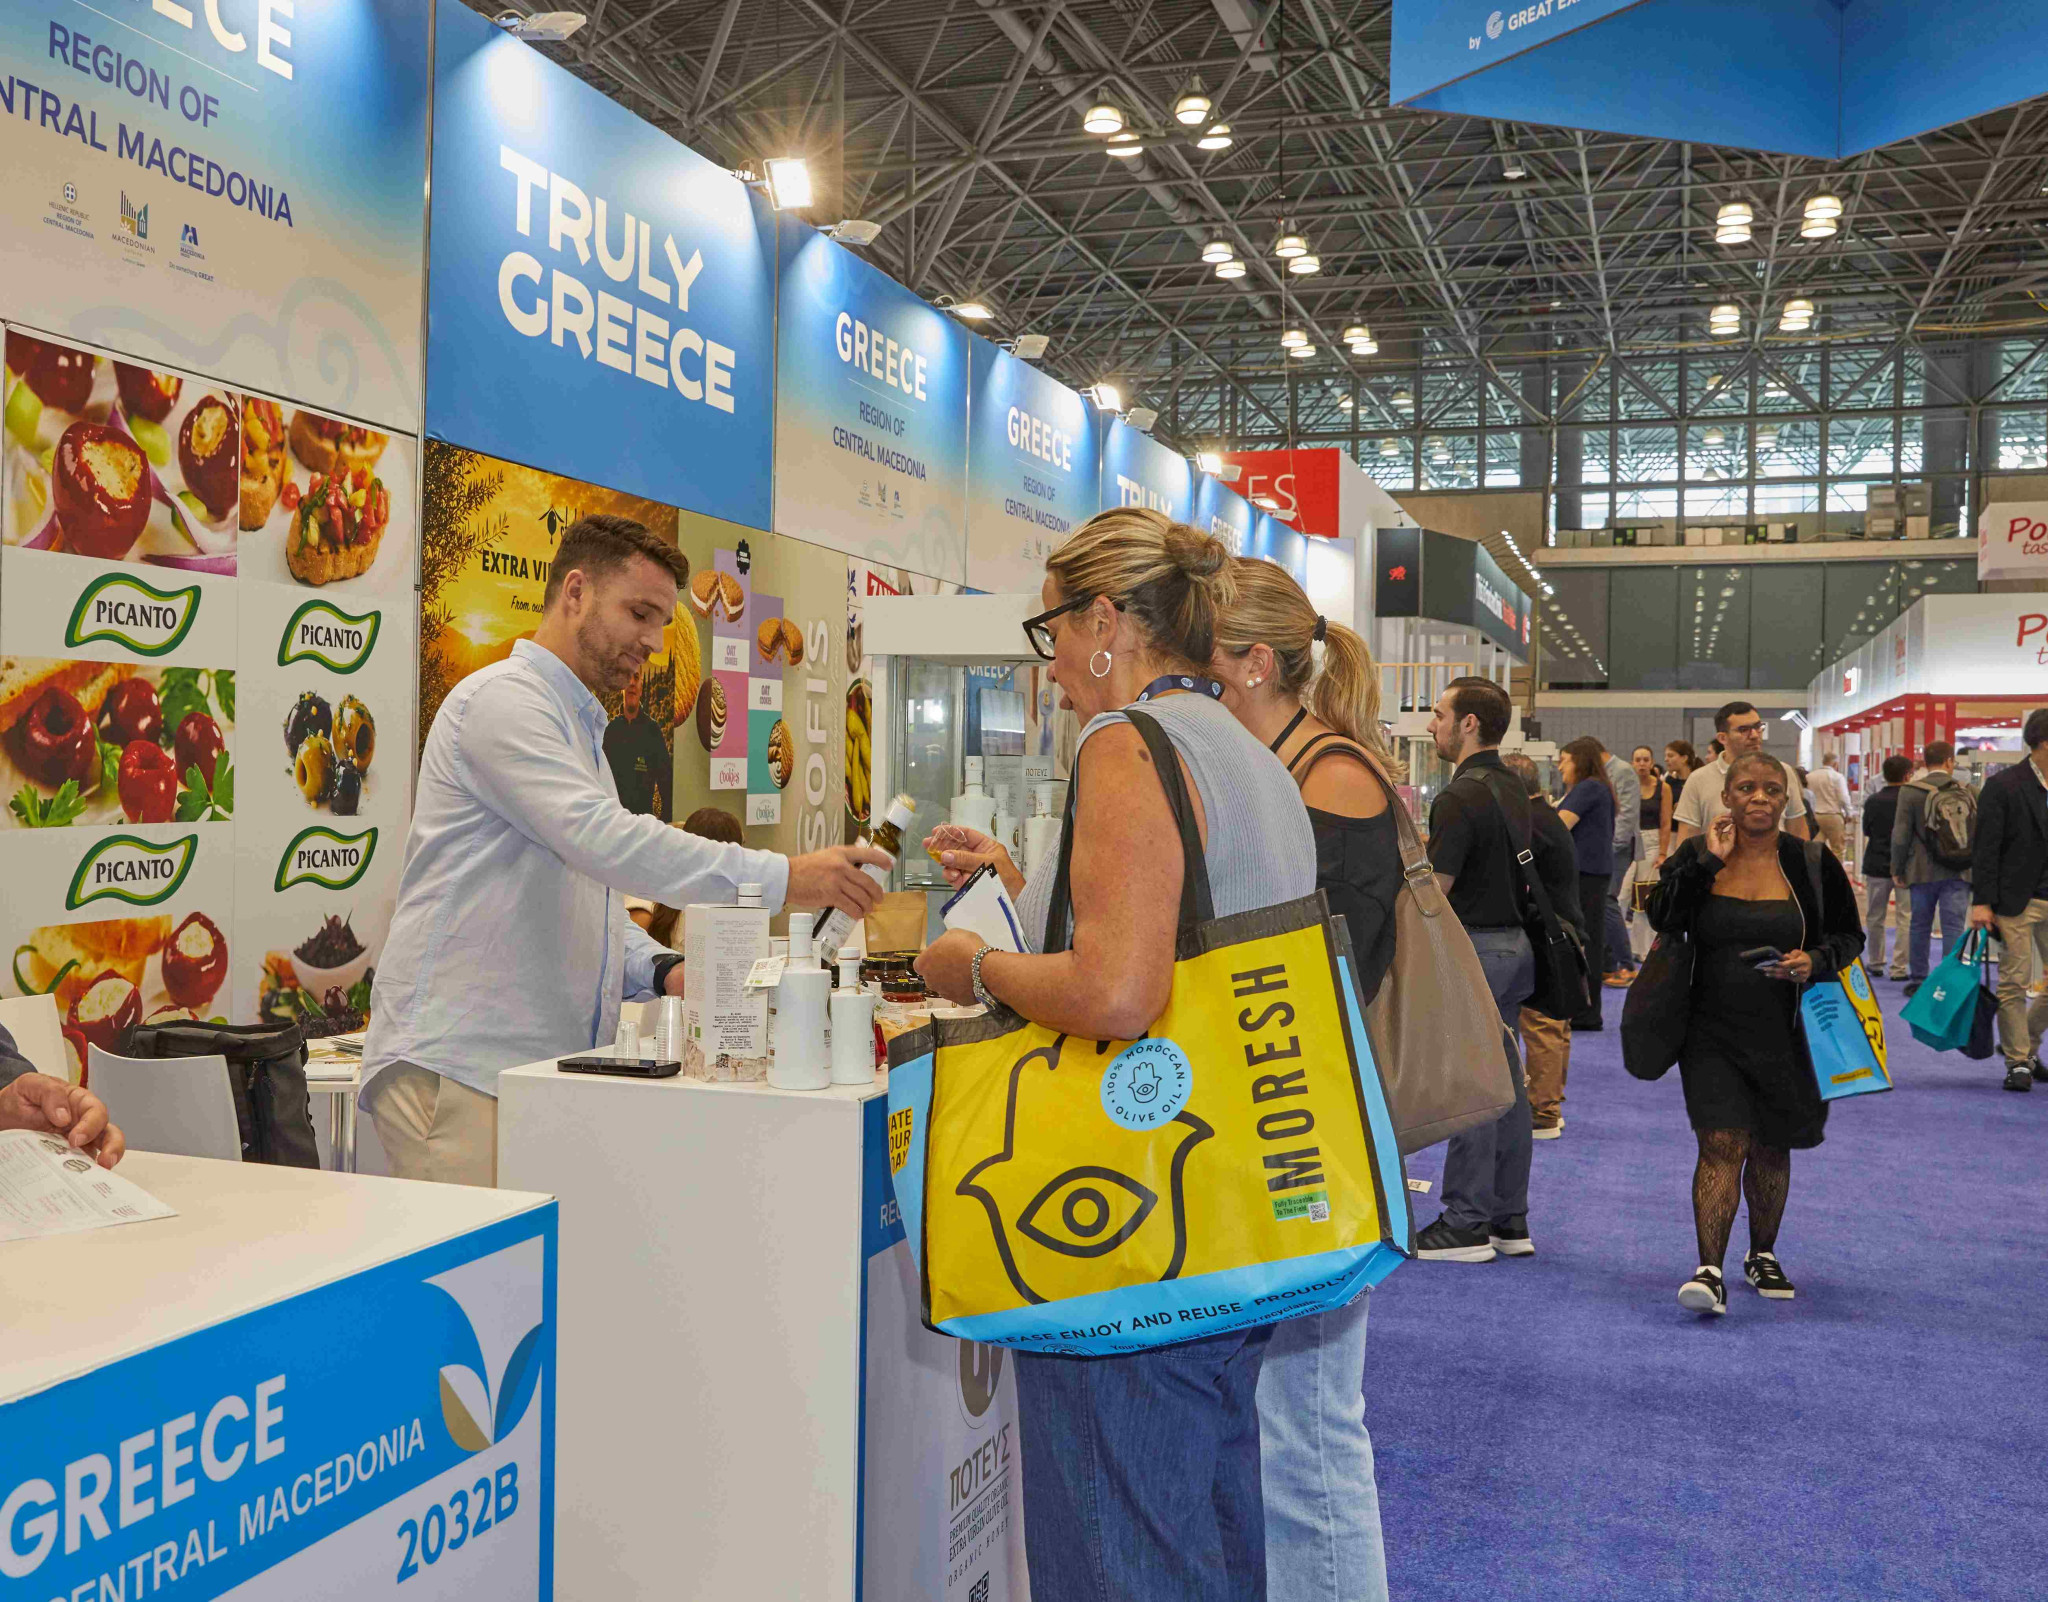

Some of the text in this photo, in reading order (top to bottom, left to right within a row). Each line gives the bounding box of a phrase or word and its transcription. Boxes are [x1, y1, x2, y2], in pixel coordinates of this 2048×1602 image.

[1469, 36, 1481, 50] by
[1508, 0, 1554, 31] GREAT
[49, 20, 220, 128] REGION OF
[117, 122, 294, 228] MACEDONIA
[42, 216, 95, 240] CENTRAL MACEDONIA
[48, 200, 69, 215] HELLENIC
[56, 212, 83, 227] REGION OF
[500, 143, 704, 313] TRULY
[112, 233, 156, 254] MACEDONIAN
[498, 251, 736, 415] GREECE
[835, 311, 927, 402] GREECE
[859, 400, 905, 438] REGION OF
[1007, 406, 1072, 473] GREECE
[833, 426, 927, 482] CENTRAL MACEDONIA
[1005, 498, 1070, 535] CENTRAL MACEDONIA
[1023, 475, 1056, 502] REGION OF
[482, 549, 551, 583] EXTRA VI
[1107, 1044, 1185, 1096] 100% MOROCCAN
[1231, 964, 1325, 1192] MORESH
[1116, 1093, 1181, 1122] OLIVE OIL
[983, 1333, 1057, 1345] PLEASE
[1060, 1320, 1124, 1340] ENJOY
[1132, 1312, 1173, 1331] AND
[1178, 1302, 1244, 1323] REUSE
[1213, 1324, 1230, 1333] not
[1230, 1317, 1259, 1328] only
[0, 1373, 286, 1579] GREECE
[239, 1417, 426, 1547] MACEDONIA
[396, 1461, 520, 1585] 2032B
[949, 1475, 1009, 1544] PREMIUM QUALITY ORGANIC
[949, 1491, 1009, 1563] EXTRA VIRGIN OLIVE OIL
[949, 1515, 1010, 1588] ORGANIC HONEY
